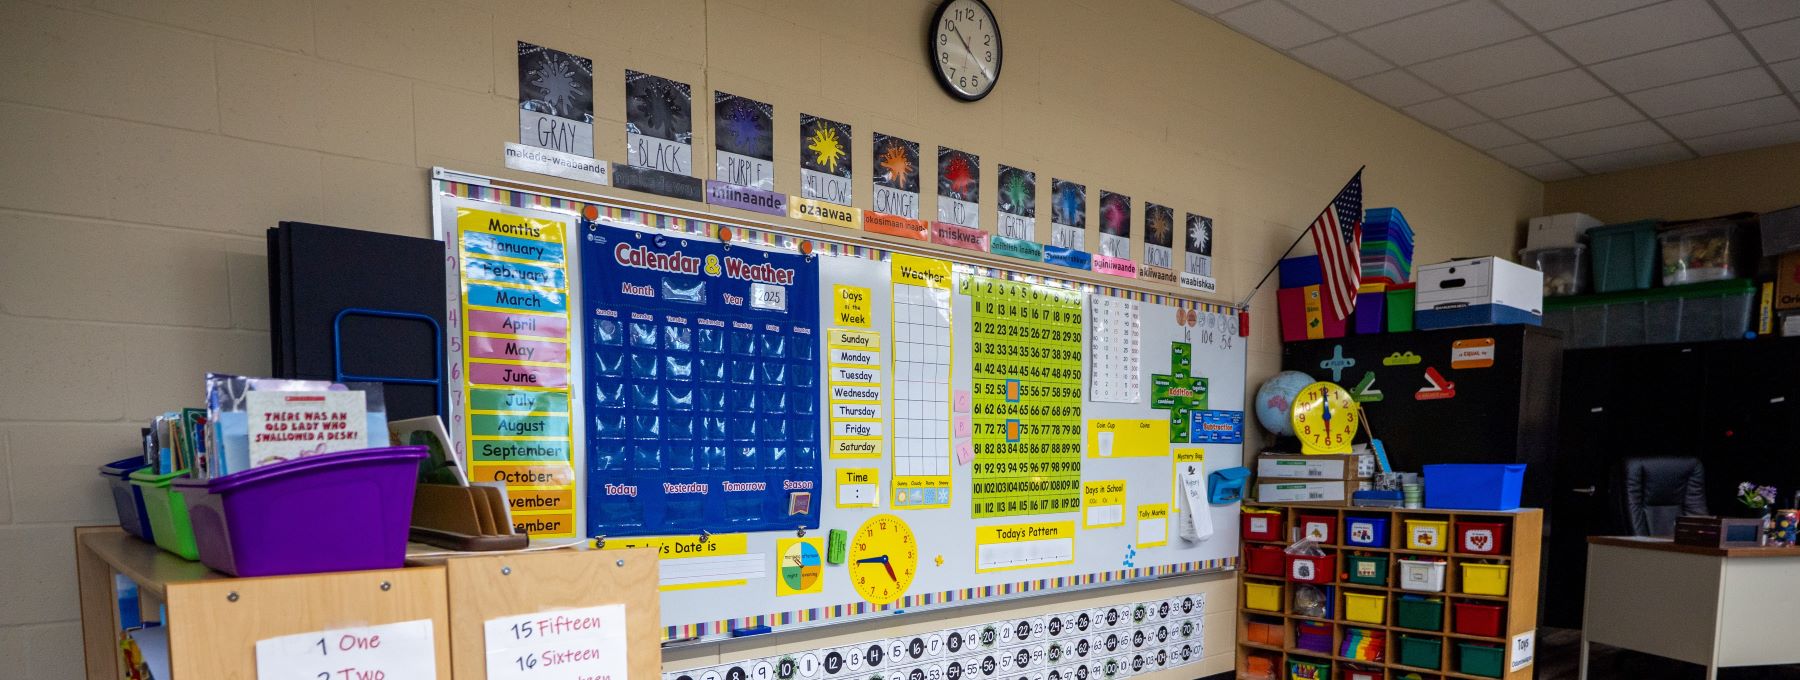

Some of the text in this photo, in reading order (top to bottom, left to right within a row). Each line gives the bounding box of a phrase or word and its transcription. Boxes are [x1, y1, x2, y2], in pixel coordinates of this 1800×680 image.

[956, 9, 962, 21] 11
[966, 8, 974, 21] 12
[945, 19, 954, 32] 10
[979, 19, 982, 30] 1
[940, 34, 947, 45] 9
[984, 35, 991, 46] 2
[942, 52, 948, 64] 8
[985, 51, 991, 62] 3
[950, 68, 956, 79] 7
[960, 77, 966, 87] 6
[972, 75, 978, 87] 5
[538, 117, 576, 153] GRAY
[506, 147, 606, 175] makade-waabaande
[639, 138, 681, 172] BLACK
[806, 175, 847, 203] YELLOW
[713, 185, 782, 209] miinaande
[877, 189, 913, 218] ORANGE
[800, 204, 852, 222] ozaawaa
[954, 201, 965, 224] RED
[489, 218, 540, 238] Months
[1006, 216, 1026, 240] GREEN
[487, 237, 544, 259] January
[615, 242, 795, 285] Calendar & Weather
[1191, 256, 1206, 275] WHITE
[900, 266, 944, 283] Weather
[1181, 276, 1215, 290] waabishkaa
[622, 282, 655, 297] Month
[496, 292, 541, 308] March
[723, 293, 743, 306] Year
[758, 289, 781, 304] 2025
[842, 290, 862, 302] Days
[450, 310, 457, 328] 4
[596, 308, 618, 318] Sunday
[631, 312, 654, 321] Monday
[841, 313, 865, 323] Week
[502, 317, 536, 333] April
[666, 315, 687, 324] Tuesday
[975, 322, 1081, 343] 21 22 23 24 25 26 27 28 29 30
[1201, 330, 1213, 344] 10¢
[451, 337, 461, 352] 5
[841, 334, 869, 345] Sunday
[1220, 335, 1232, 350] 5¢
[505, 343, 534, 360] May
[841, 352, 871, 364] Monday
[452, 363, 460, 380] 6
[503, 369, 537, 383] June
[840, 370, 872, 382] Tuesday
[834, 389, 878, 400] Wednesday
[1169, 387, 1193, 397] Addition
[1308, 392, 1317, 400] 11
[1334, 391, 1338, 400] 1
[505, 393, 535, 407] July
[1343, 400, 1348, 408] 2
[264, 412, 347, 421] THERE WAS AN
[839, 406, 875, 418] Thursday
[1299, 414, 1305, 422] 9
[1347, 413, 1353, 422] 3
[265, 422, 346, 431] OLD LADY WHO
[498, 419, 545, 435] August
[845, 424, 871, 433] Friday
[1305, 426, 1310, 434] 8
[1344, 425, 1350, 434] 4
[256, 432, 358, 442] SWALLOWED A DESK!
[1314, 434, 1320, 443] 7
[1325, 437, 1331, 446] 6
[1336, 434, 1342, 443] 5
[482, 444, 562, 460] September
[839, 443, 875, 452] Saturday
[1193, 453, 1203, 461] Bag
[494, 470, 552, 482] October
[846, 473, 868, 482] Time
[605, 483, 637, 498] Today
[663, 481, 709, 495] Yesterday
[722, 480, 766, 492] Tomorrow
[783, 480, 814, 491] Season
[1085, 486, 1099, 495] Days
[1107, 484, 1123, 492] School
[509, 495, 560, 507] vember
[512, 520, 560, 532] cember
[880, 522, 886, 530] 12
[894, 525, 898, 533] 1
[996, 527, 1057, 540] Today's Pattern
[675, 541, 702, 554] Date
[707, 540, 717, 552] is
[884, 588, 888, 596] 6
[511, 616, 601, 640] 15 Fifteen
[1019, 625, 1028, 636] 22
[983, 631, 993, 643] 20
[317, 635, 380, 655] 1 One
[1518, 639, 1529, 651] Toys
[516, 649, 600, 671] 16 Sixteen
[829, 657, 837, 669] 12
[337, 668, 385, 680] Two
[782, 663, 791, 676] 10
